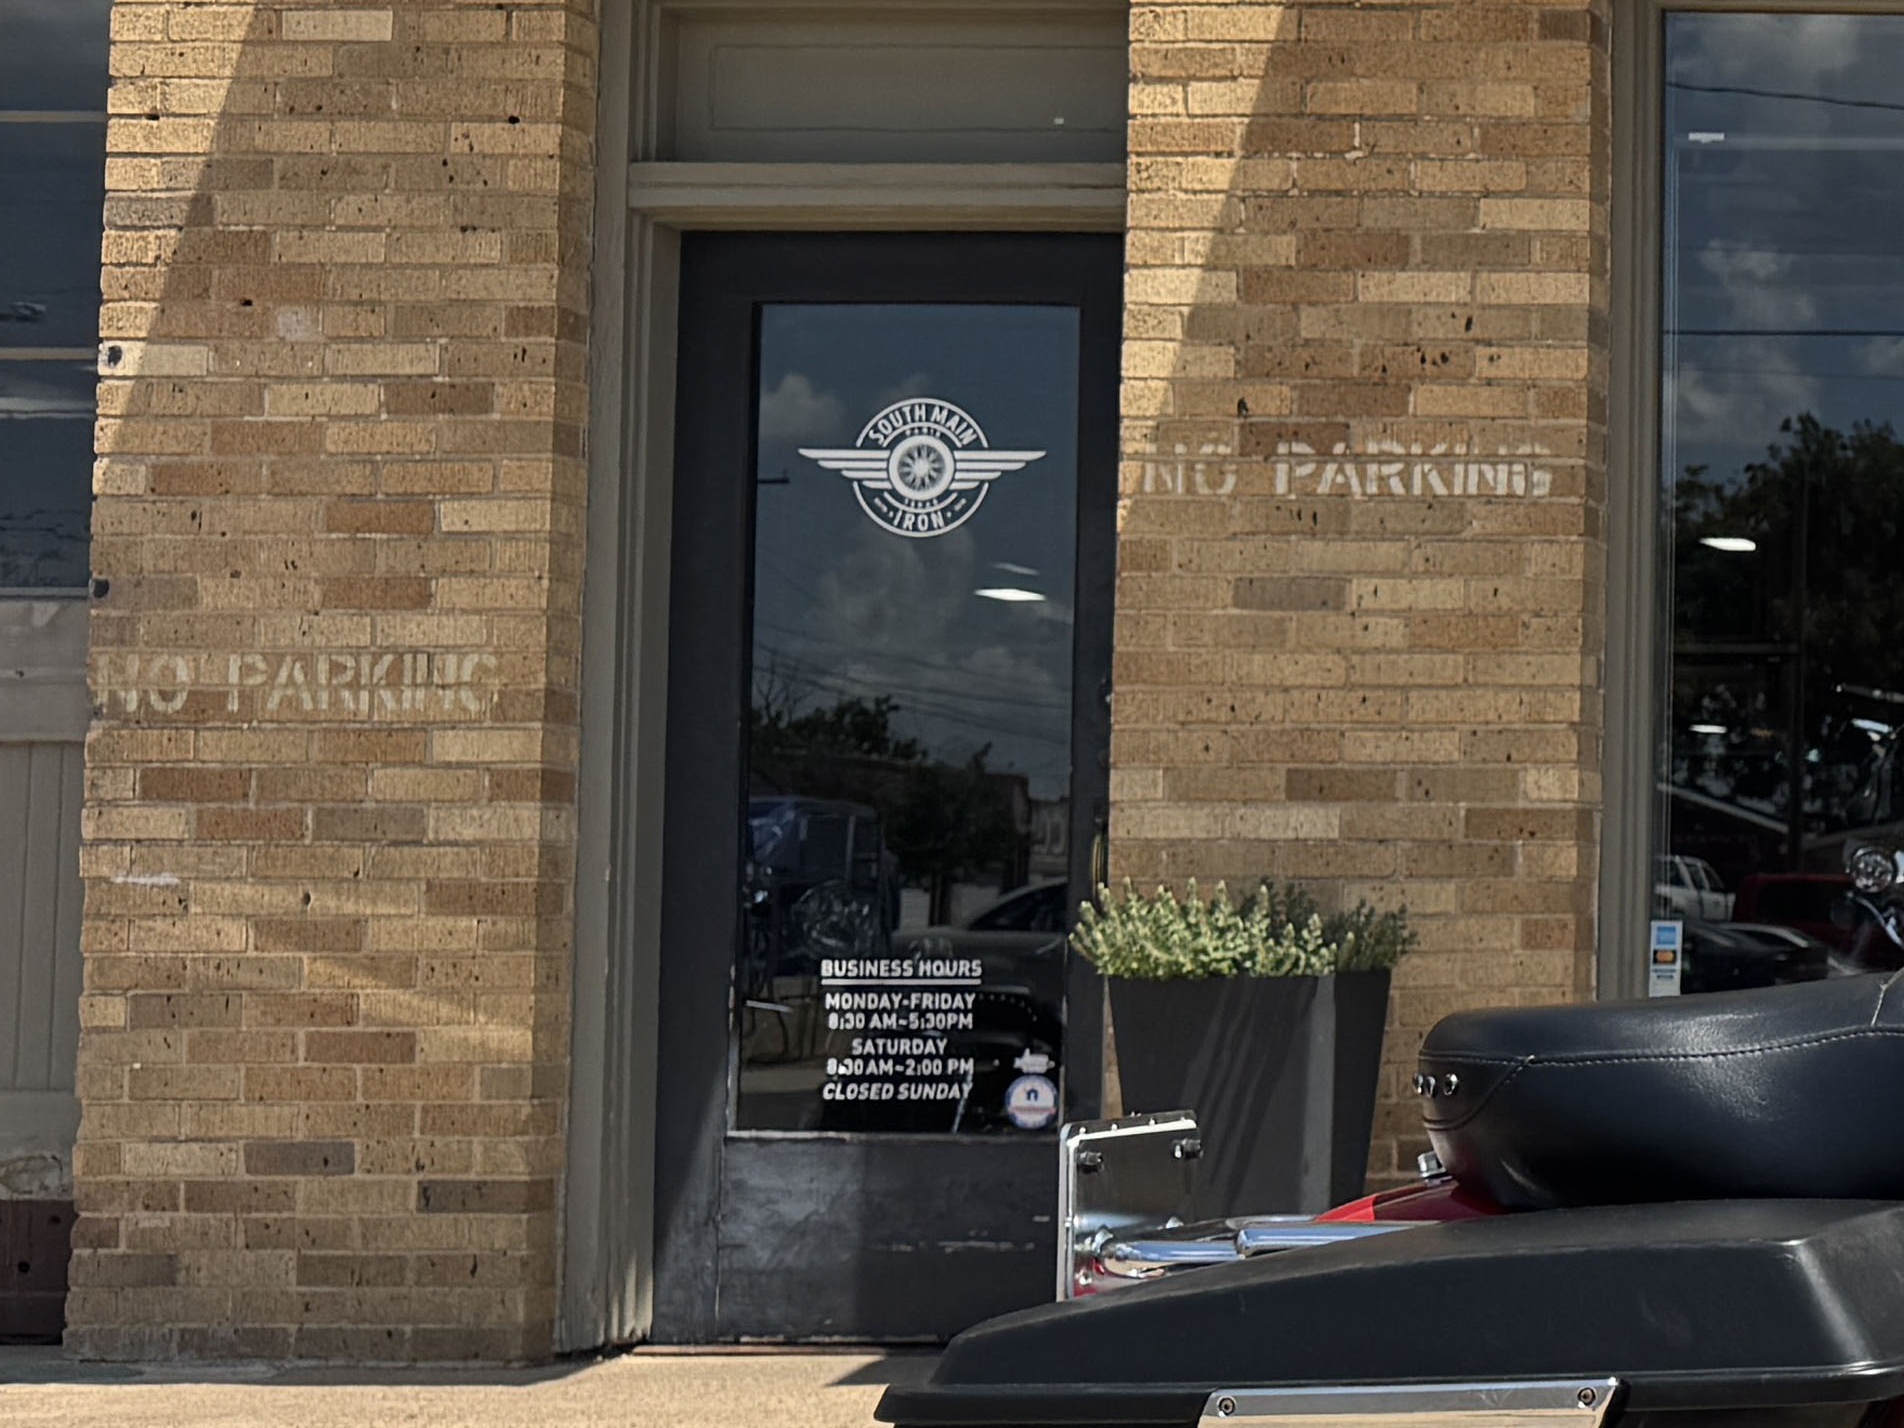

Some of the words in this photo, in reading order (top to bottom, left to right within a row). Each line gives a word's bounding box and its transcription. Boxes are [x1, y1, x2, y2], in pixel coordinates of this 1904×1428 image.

[868, 403, 926, 446] SOUTH
[931, 404, 978, 447] MAIN
[1142, 442, 1237, 495] NO
[1275, 441, 1553, 496] PARKING
[892, 510, 945, 532] IRON
[95, 653, 191, 714] NO
[227, 653, 499, 715] PARKING
[820, 958, 914, 978] BUSINESS
[918, 958, 983, 978] HOURS
[824, 992, 976, 1010] MONDAY-FRIDAY
[828, 1012, 866, 1030] 8:30
[851, 1038, 948, 1056] SATURDAY
[822, 1082, 894, 1100] CLOSED
[896, 1082, 974, 1100] SUNDAY
